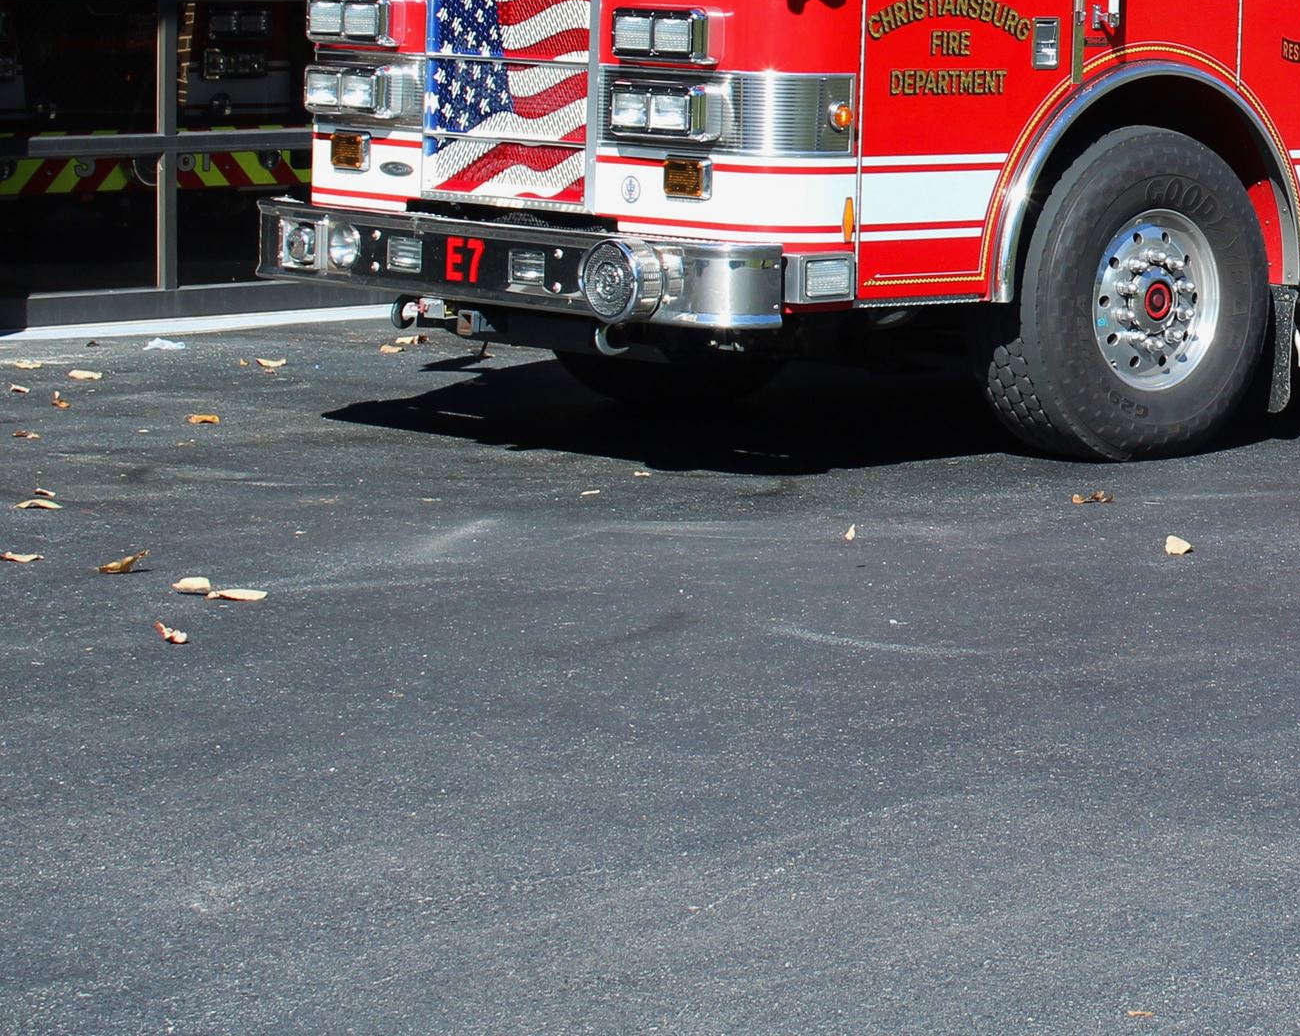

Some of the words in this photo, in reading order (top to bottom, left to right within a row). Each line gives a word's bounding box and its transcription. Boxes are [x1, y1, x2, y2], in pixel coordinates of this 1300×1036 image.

[929, 29, 972, 57] FIRE
[889, 68, 1008, 97] DEPARTMENT
[445, 235, 486, 284] E7
